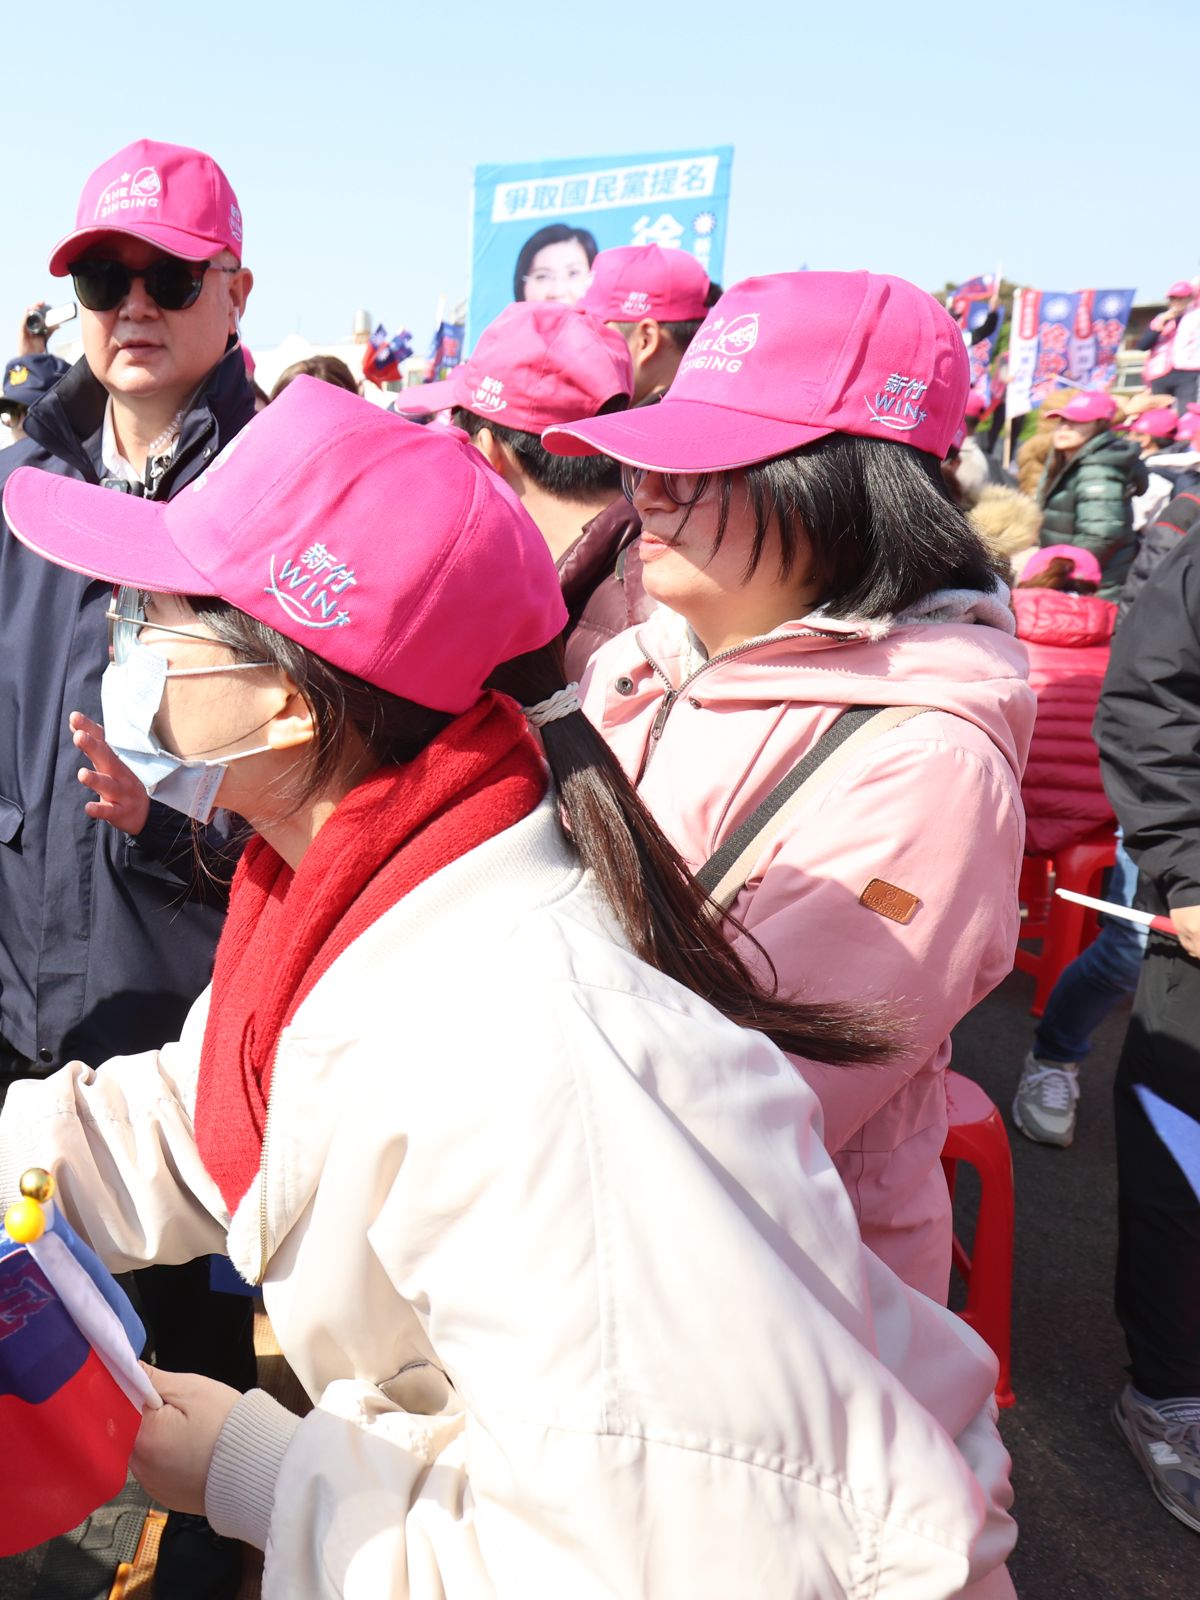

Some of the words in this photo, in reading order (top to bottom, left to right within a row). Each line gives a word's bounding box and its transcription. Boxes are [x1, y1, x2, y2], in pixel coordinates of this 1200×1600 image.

[104, 186, 129, 205] SHE
[504, 164, 707, 215] 爭取國民黨提名
[101, 197, 160, 218] SINGING
[475, 388, 501, 408] WIN
[883, 372, 928, 400] 新竹
[875, 392, 920, 420] WIN
[300, 542, 357, 593] 新竹
[279, 559, 338, 619] WIN
